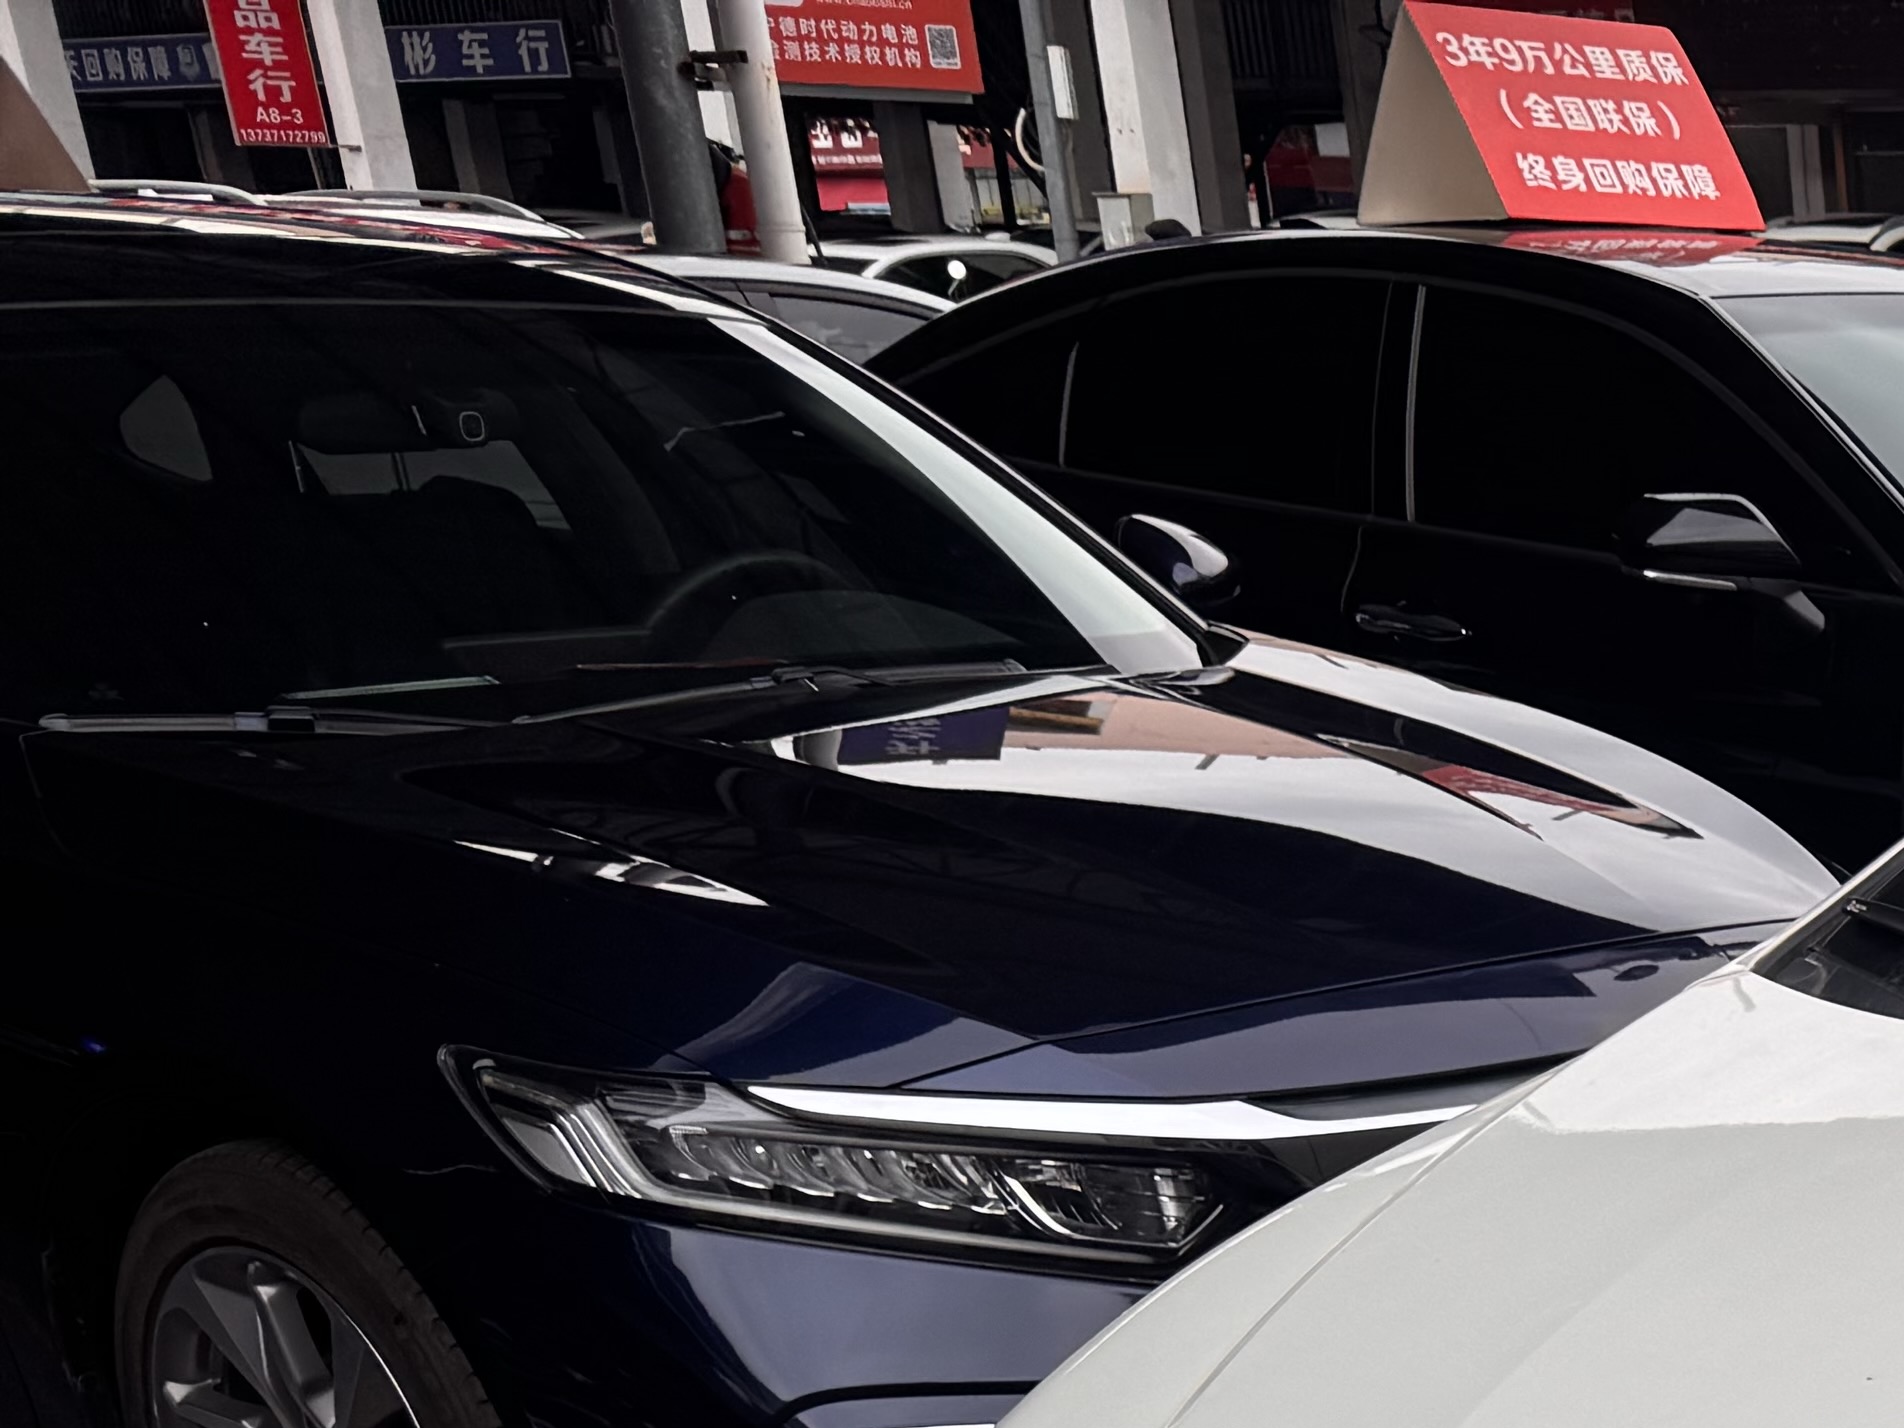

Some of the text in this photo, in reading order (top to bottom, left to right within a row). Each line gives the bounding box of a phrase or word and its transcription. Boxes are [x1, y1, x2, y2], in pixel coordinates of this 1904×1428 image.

[1435, 31, 1690, 86] 3年9万公里质保
[256, 106, 304, 125] A8-3
[1516, 152, 1722, 201] 终身回购保障
